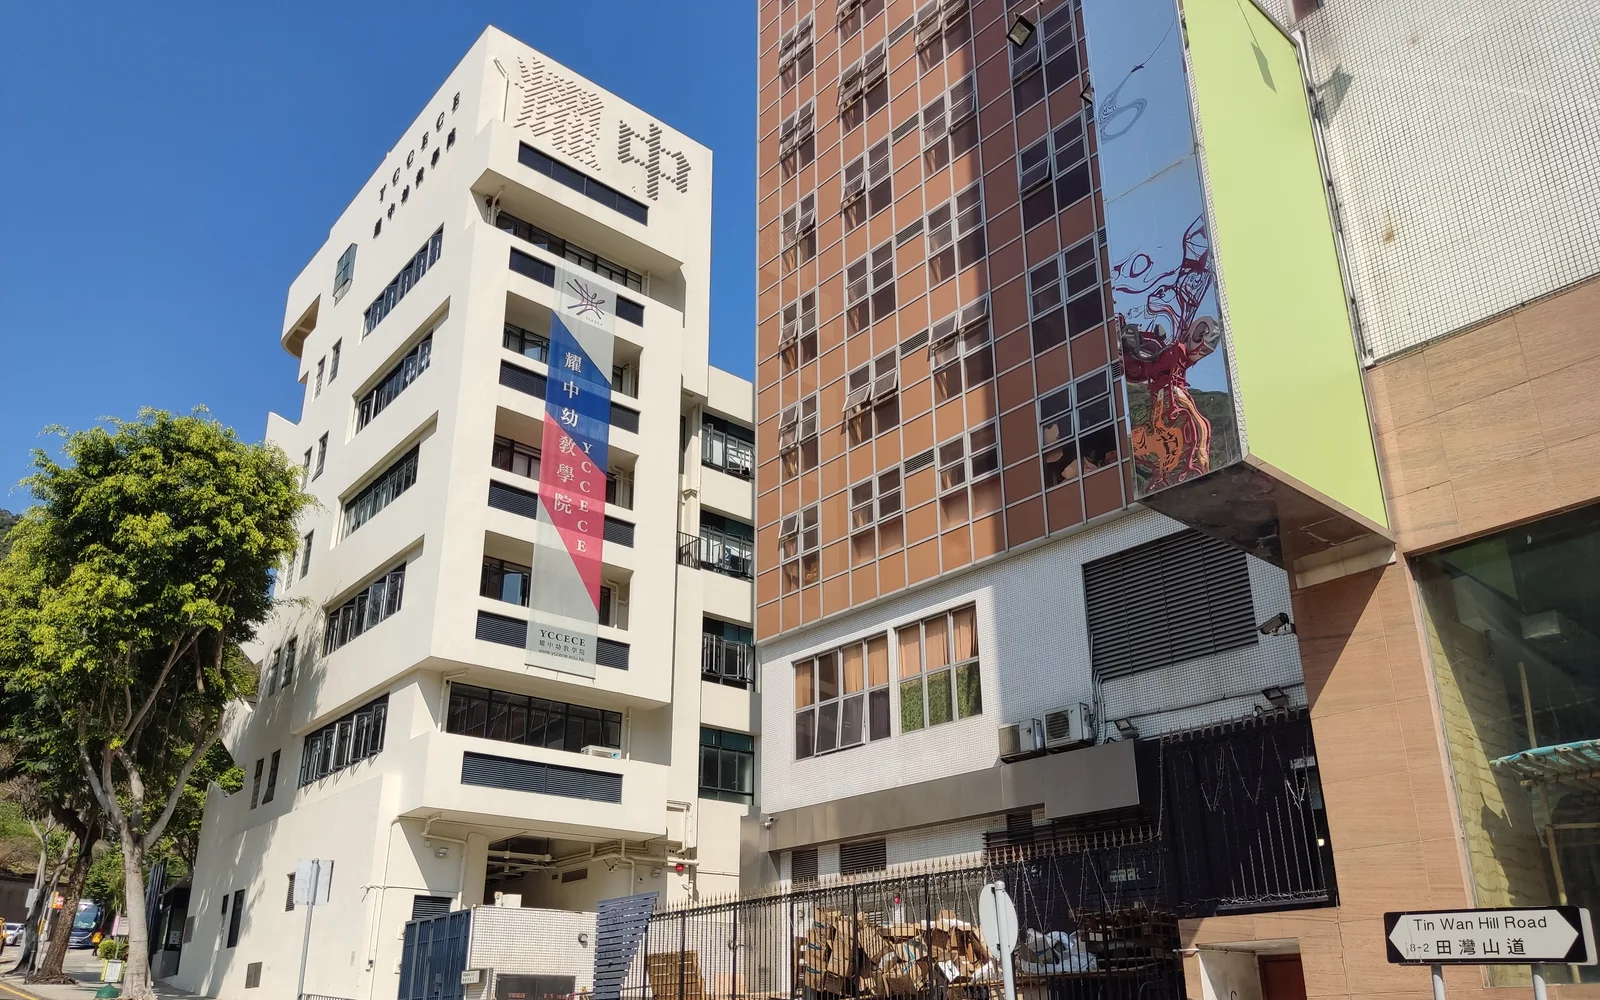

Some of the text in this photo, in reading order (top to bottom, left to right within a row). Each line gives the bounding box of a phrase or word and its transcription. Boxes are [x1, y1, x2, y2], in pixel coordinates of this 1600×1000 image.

[379, 91, 460, 203] YCCECE
[576, 441, 593, 553] YCCECE
[540, 629, 586, 647] YCCECE
[1413, 915, 1548, 931] Tin Wan Hill Road
[1436, 937, 1527, 956] 田灣山道
